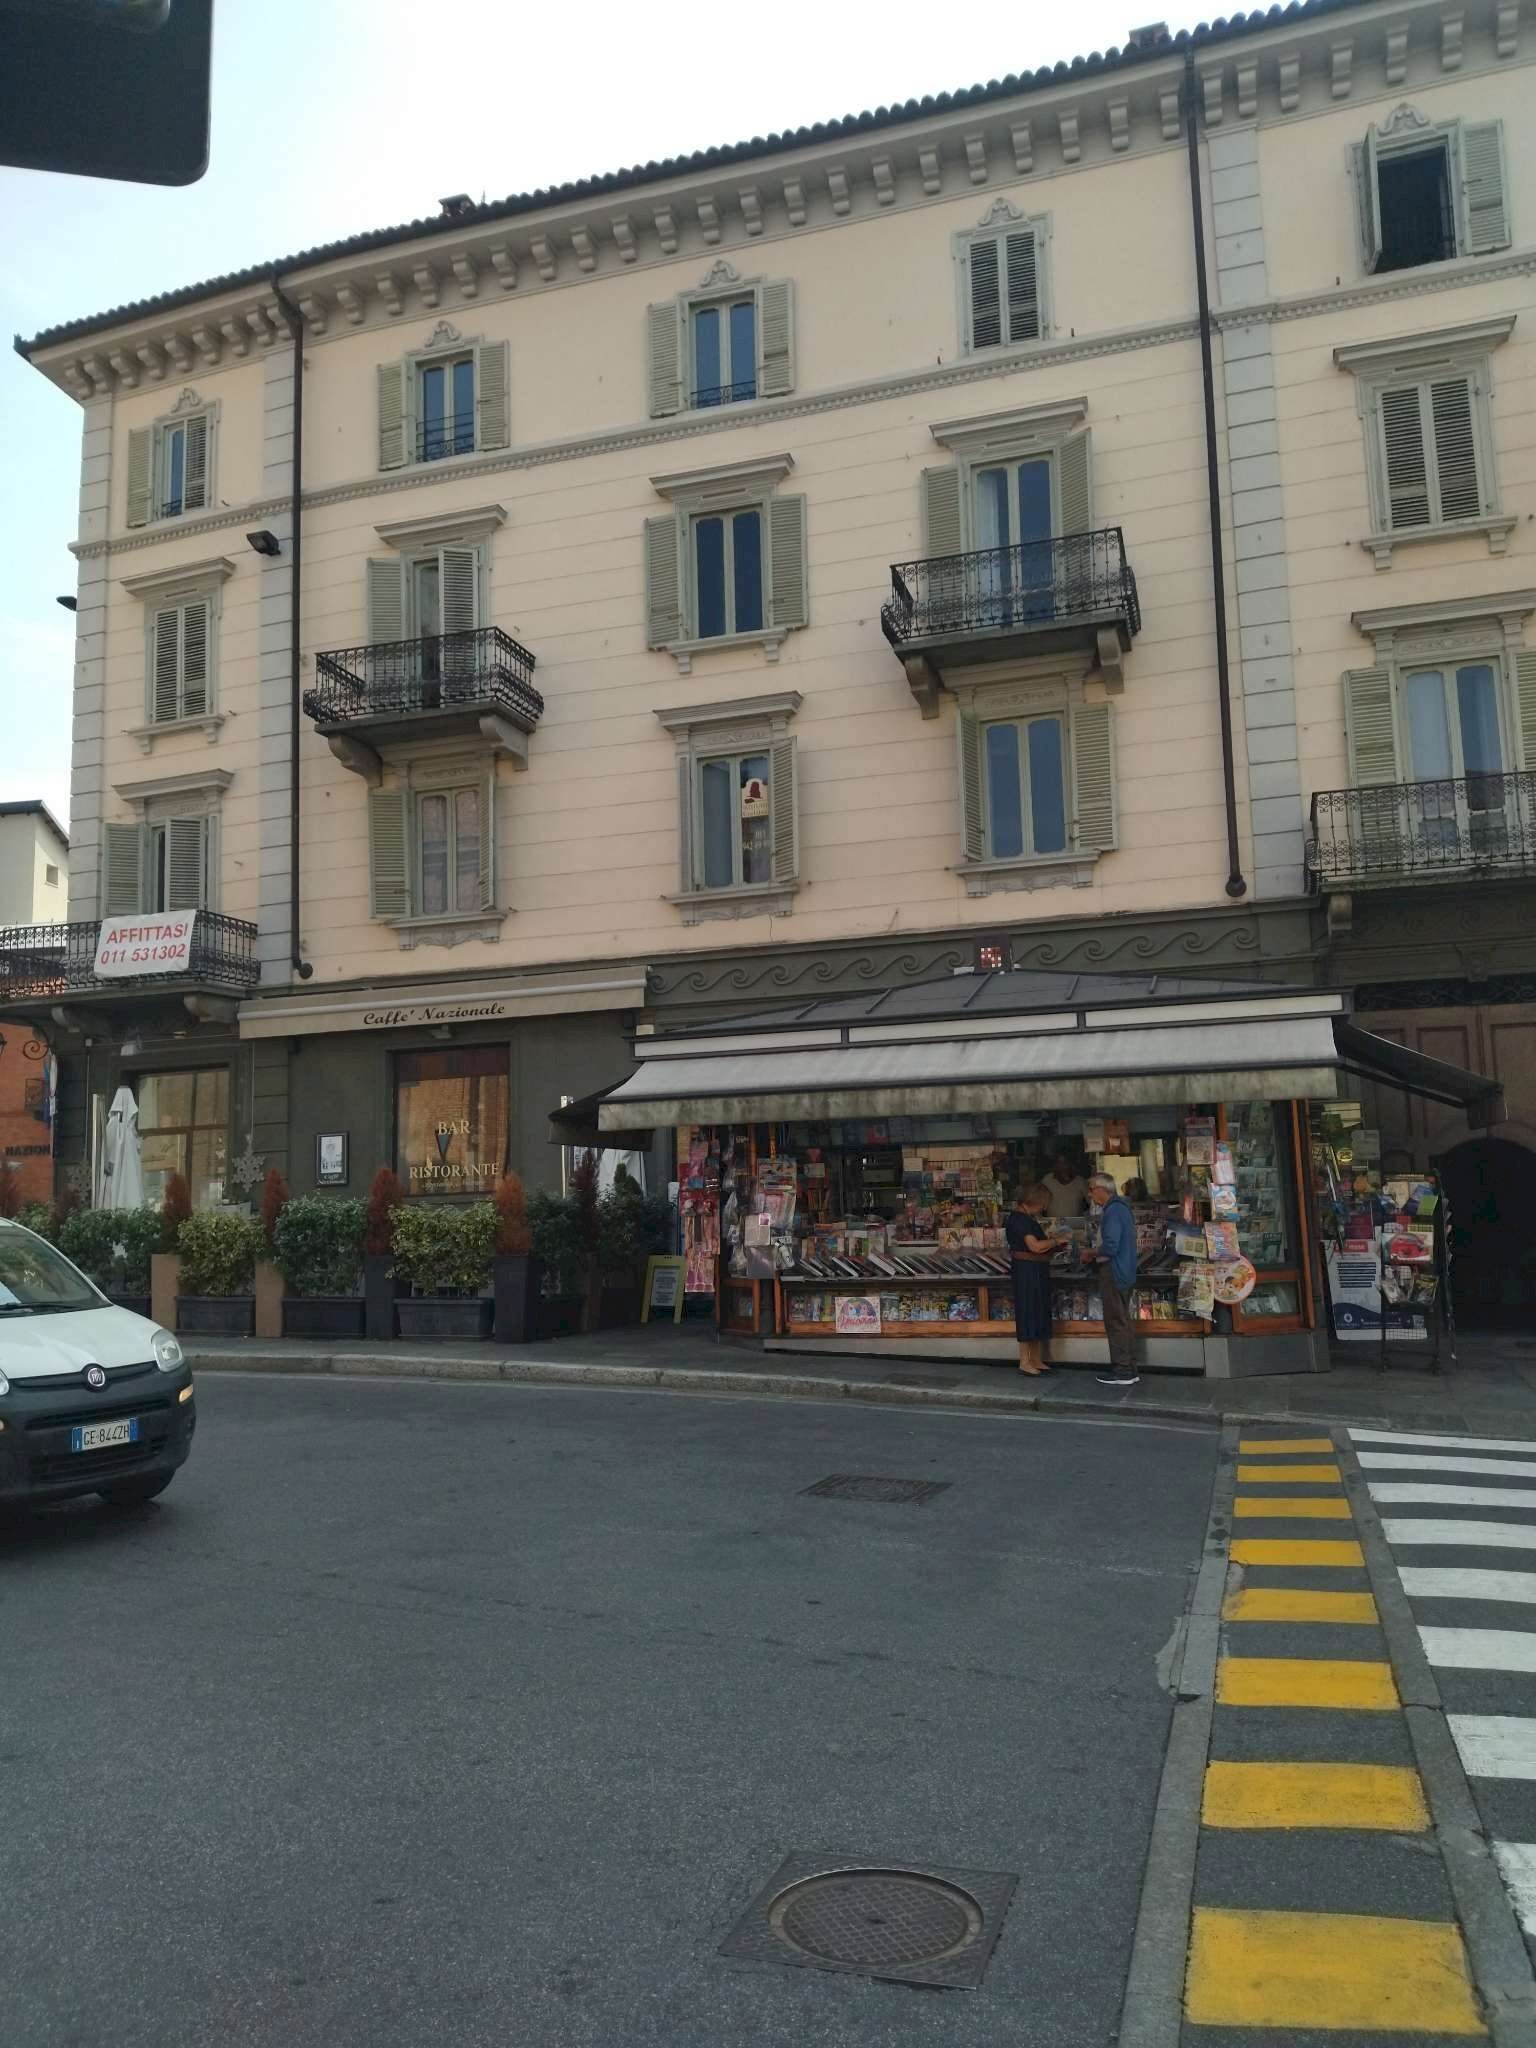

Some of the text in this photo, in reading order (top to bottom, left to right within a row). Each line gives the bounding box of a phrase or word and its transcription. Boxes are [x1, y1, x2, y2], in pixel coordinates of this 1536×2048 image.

[106, 923, 188, 944] AFFITTASI
[101, 943, 186, 965] 011 531302
[363, 1002, 505, 1025] Caffe' Nazionale
[438, 1120, 471, 1136] BAR
[409, 1162, 500, 1179] RISTORANTE
